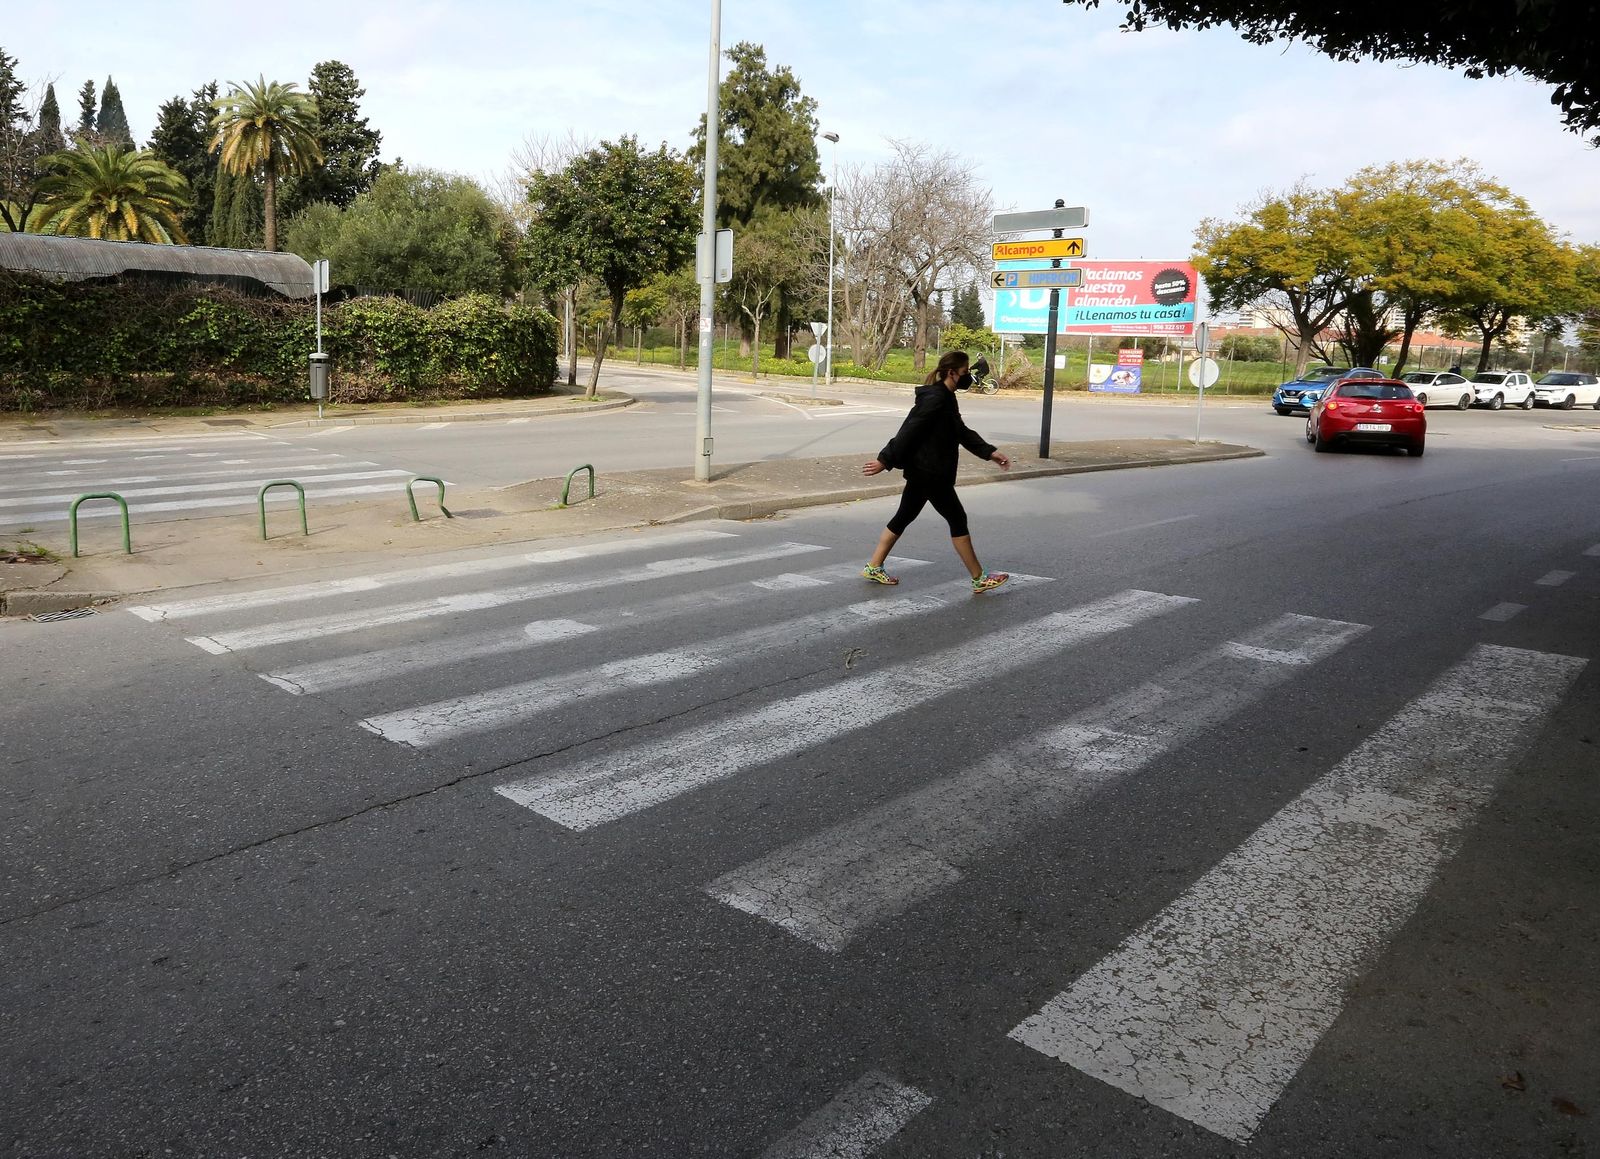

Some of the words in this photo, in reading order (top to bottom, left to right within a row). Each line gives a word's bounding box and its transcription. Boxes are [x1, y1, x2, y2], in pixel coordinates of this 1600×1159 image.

[995, 245, 1045, 256] Alcampo
[1029, 272, 1078, 284] HIPERCOR
[1074, 294, 1137, 306] almacén!
[1140, 308, 1151, 319] tu
[1154, 307, 1187, 319] casa!
